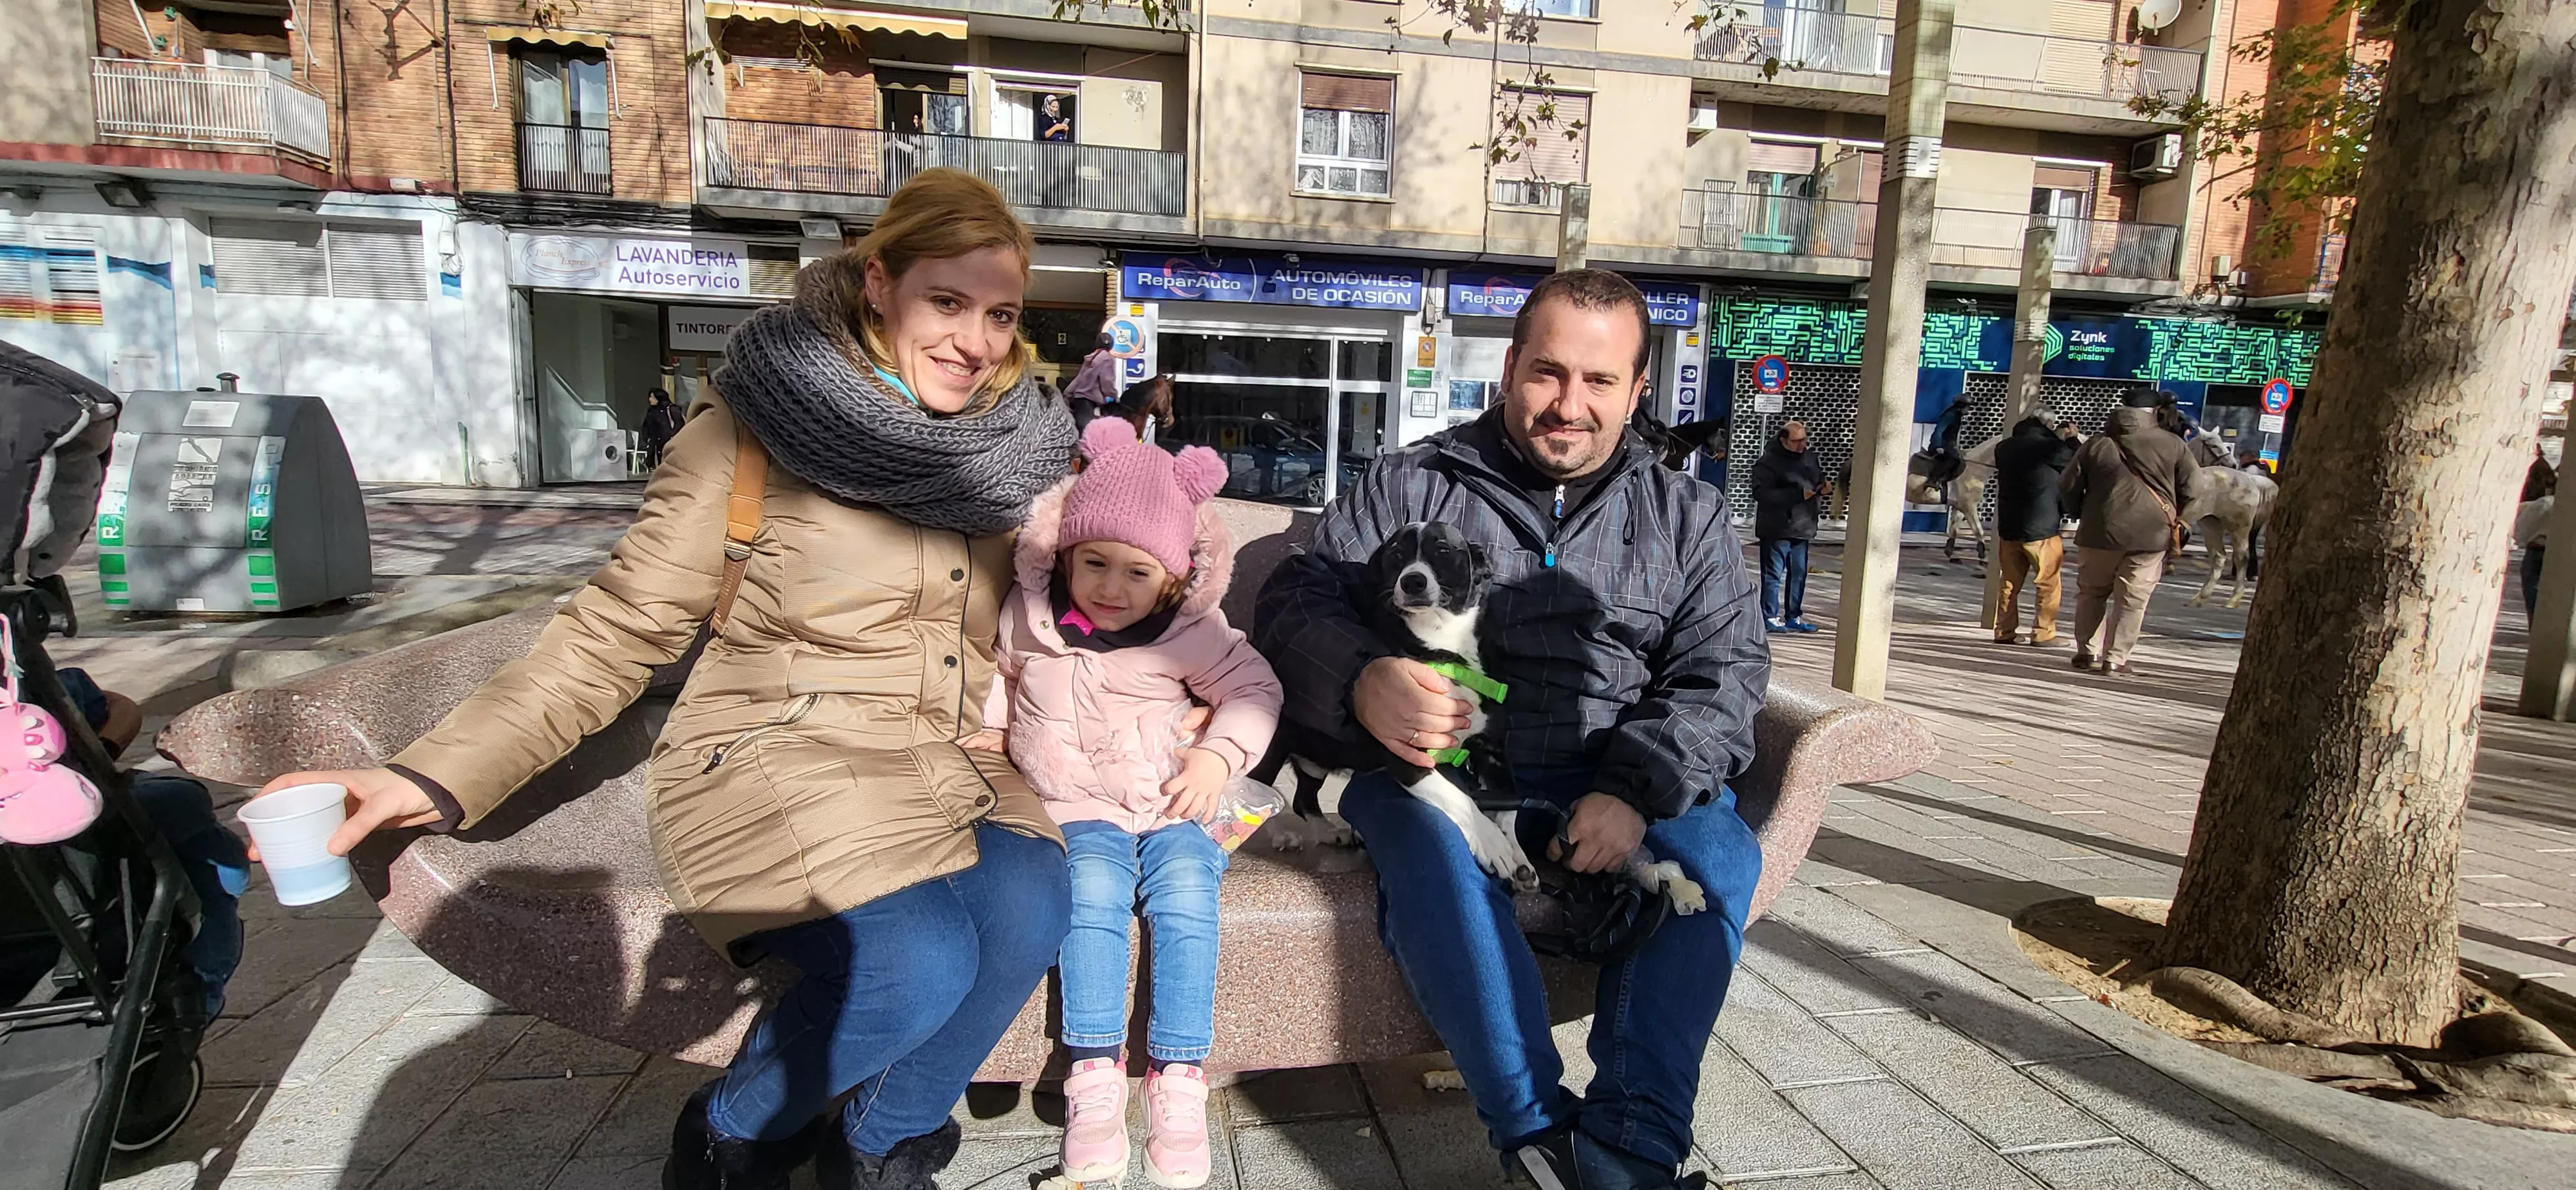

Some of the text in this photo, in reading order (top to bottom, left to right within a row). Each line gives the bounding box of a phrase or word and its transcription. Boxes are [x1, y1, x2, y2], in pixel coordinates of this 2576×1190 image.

[562, 258, 591, 267] Express
[616, 246, 738, 268] LAVANDERIA
[618, 267, 740, 289] Autoservicio
[1138, 273, 1241, 290] ReparAuto
[1271, 269, 1412, 287] AUTOMÓVILES
[1292, 288, 1411, 305] DE OCASIÓN
[2070, 330, 2107, 345] Zynk
[2068, 352, 2105, 361] digitales
